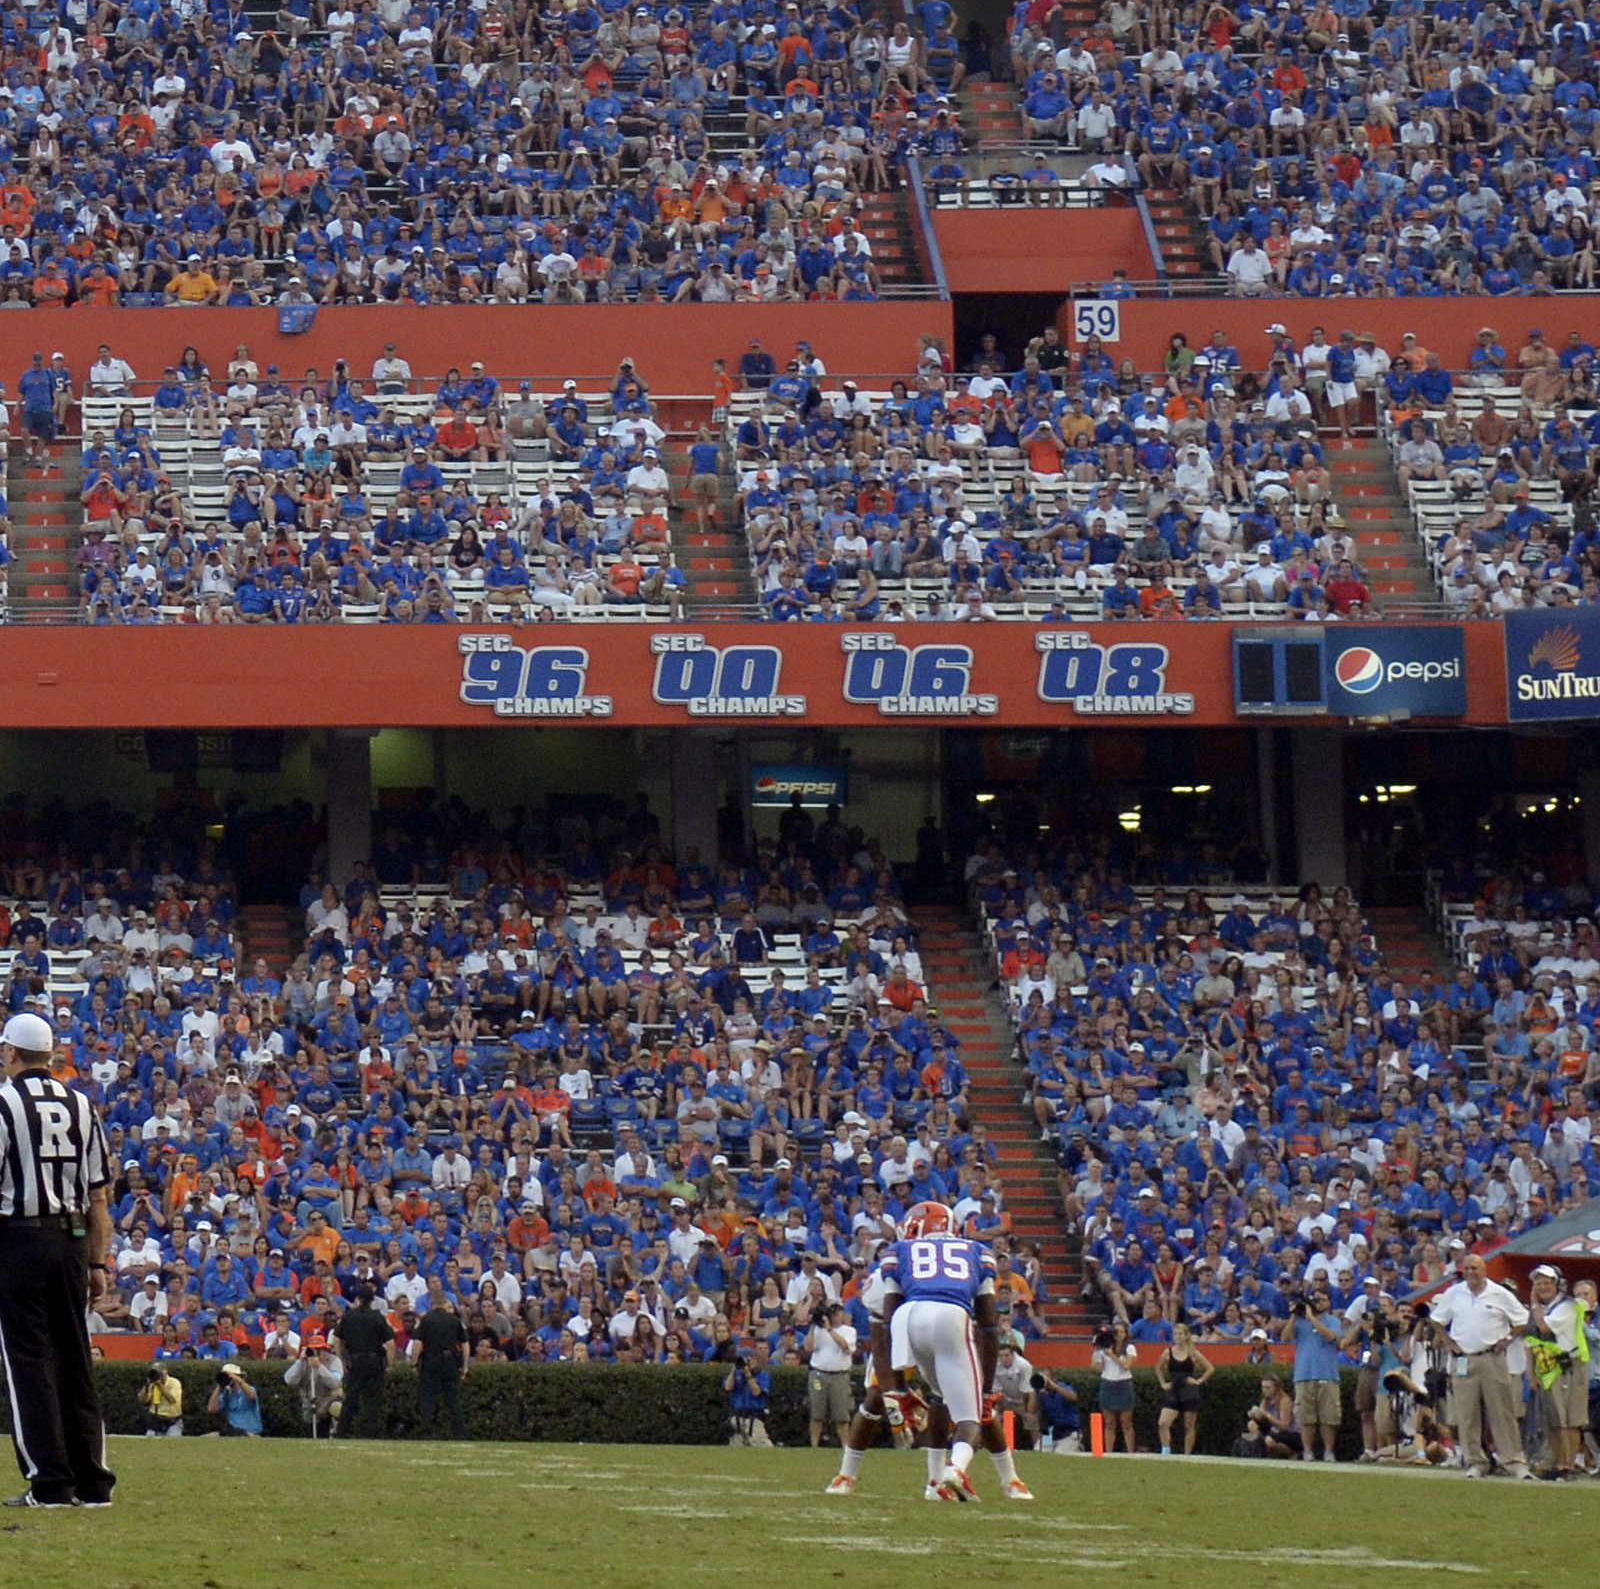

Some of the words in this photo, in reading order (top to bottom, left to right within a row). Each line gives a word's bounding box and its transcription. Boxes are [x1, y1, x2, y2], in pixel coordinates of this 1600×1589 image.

[1076, 305, 1116, 337] 59
[1210, 358, 1228, 374] 15
[459, 633, 513, 654] SEC
[651, 633, 705, 653] SEC
[842, 632, 896, 652] SEC
[1035, 630, 1090, 651] SEC
[459, 644, 590, 705] 96
[651, 644, 782, 705] 00
[842, 643, 973, 704] 06
[1035, 641, 1169, 703] 08
[1386, 657, 1460, 683] pepsi
[494, 695, 612, 717] CHAMPS
[687, 694, 806, 716] CHAMPS
[878, 693, 999, 716] CHAMPS
[1074, 691, 1195, 715] CHAMPS
[34, 1101, 76, 1158] R
[909, 1241, 969, 1280] 85
